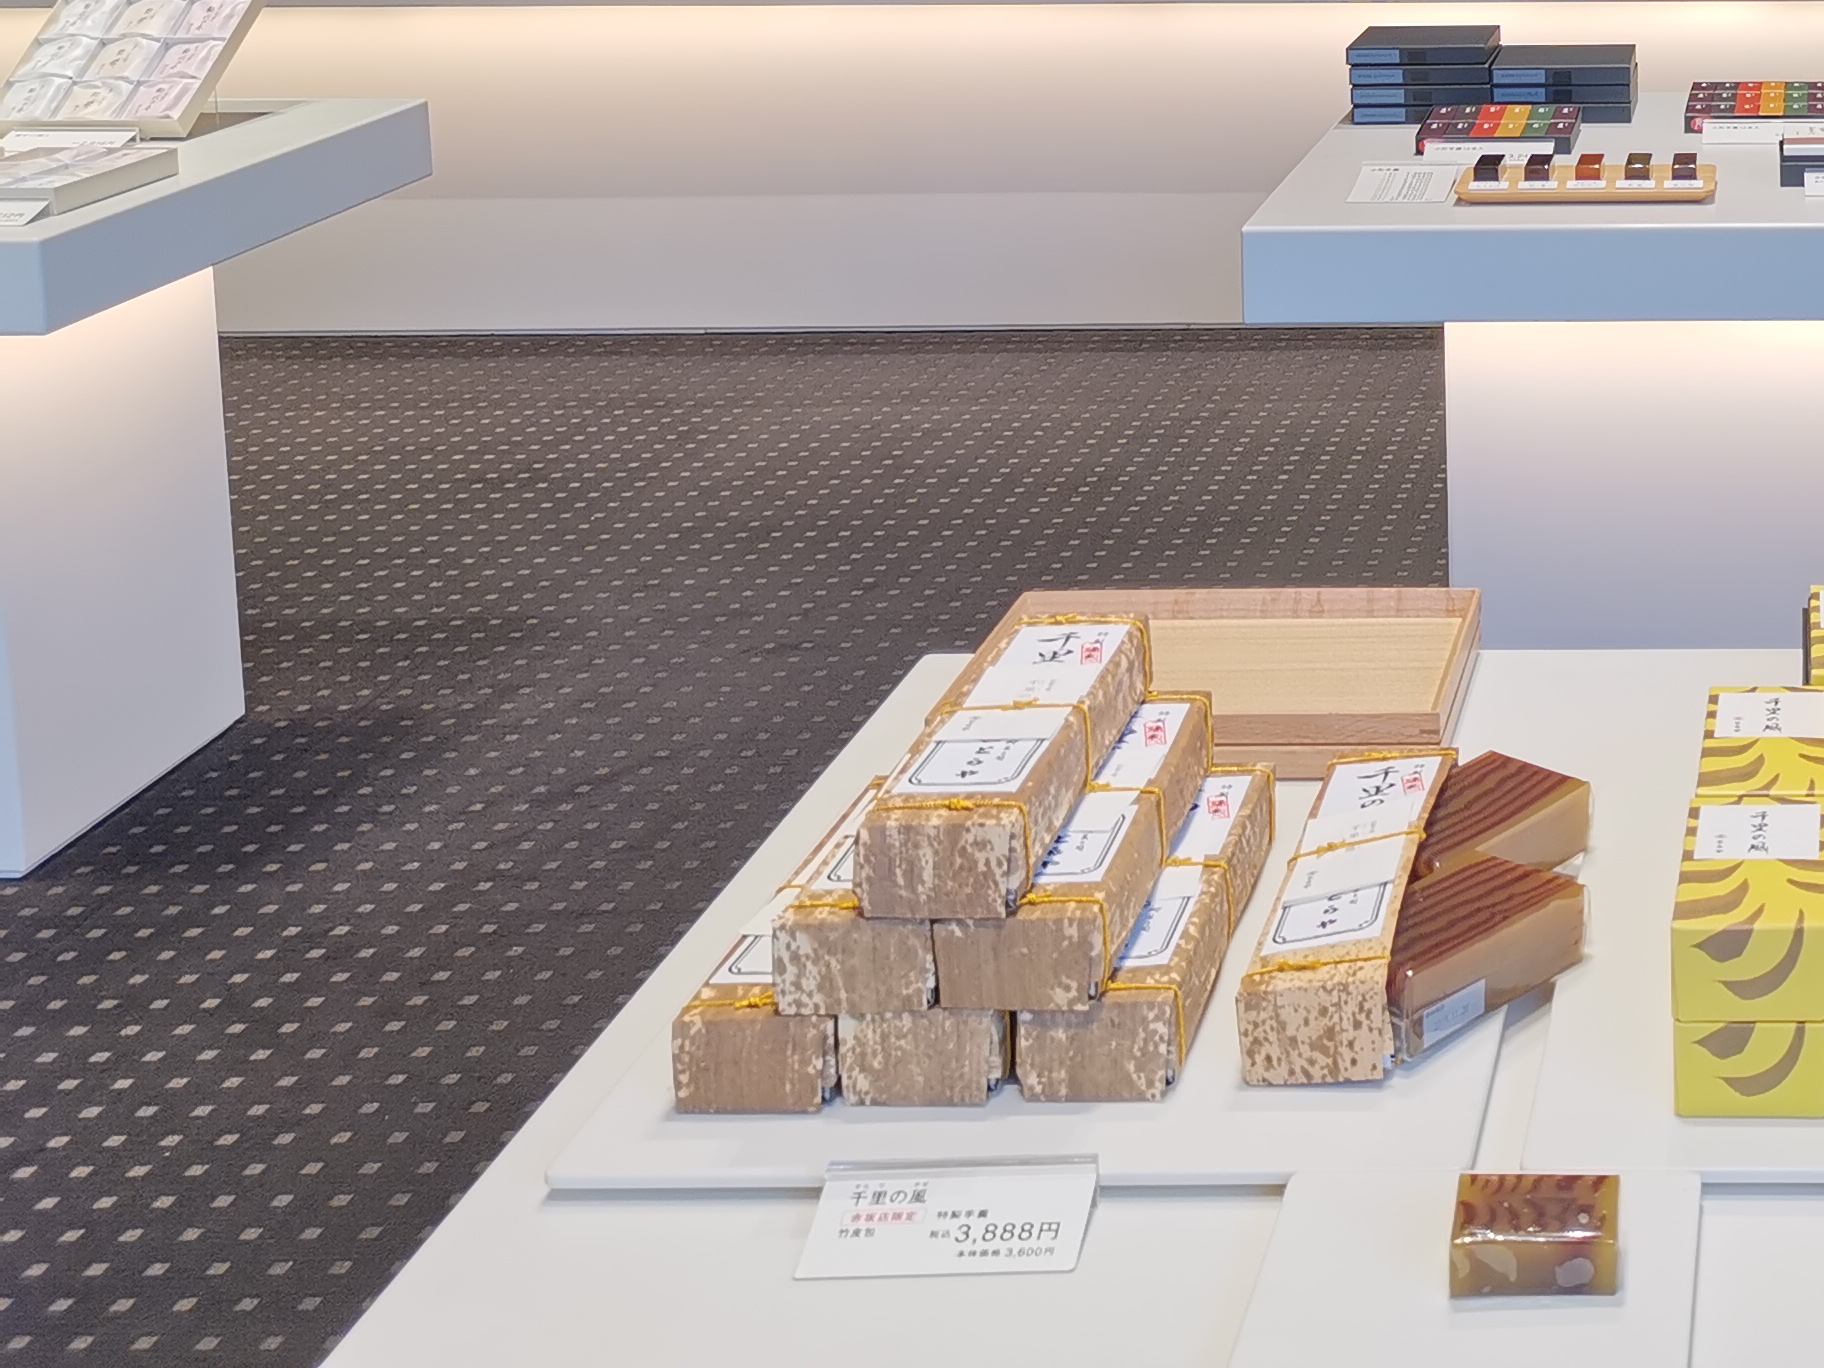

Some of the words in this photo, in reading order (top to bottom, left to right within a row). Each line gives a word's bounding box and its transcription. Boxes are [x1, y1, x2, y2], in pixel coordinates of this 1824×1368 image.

[1762, 697, 1783, 733] 千里の風
[1747, 810, 1770, 854] 千里の風
[850, 1187, 927, 1207] 千里の風
[849, 1211, 918, 1224] 赤坂店限定
[954, 1221, 1061, 1245] 3,888円
[1004, 1245, 1055, 1259] 3,600円
